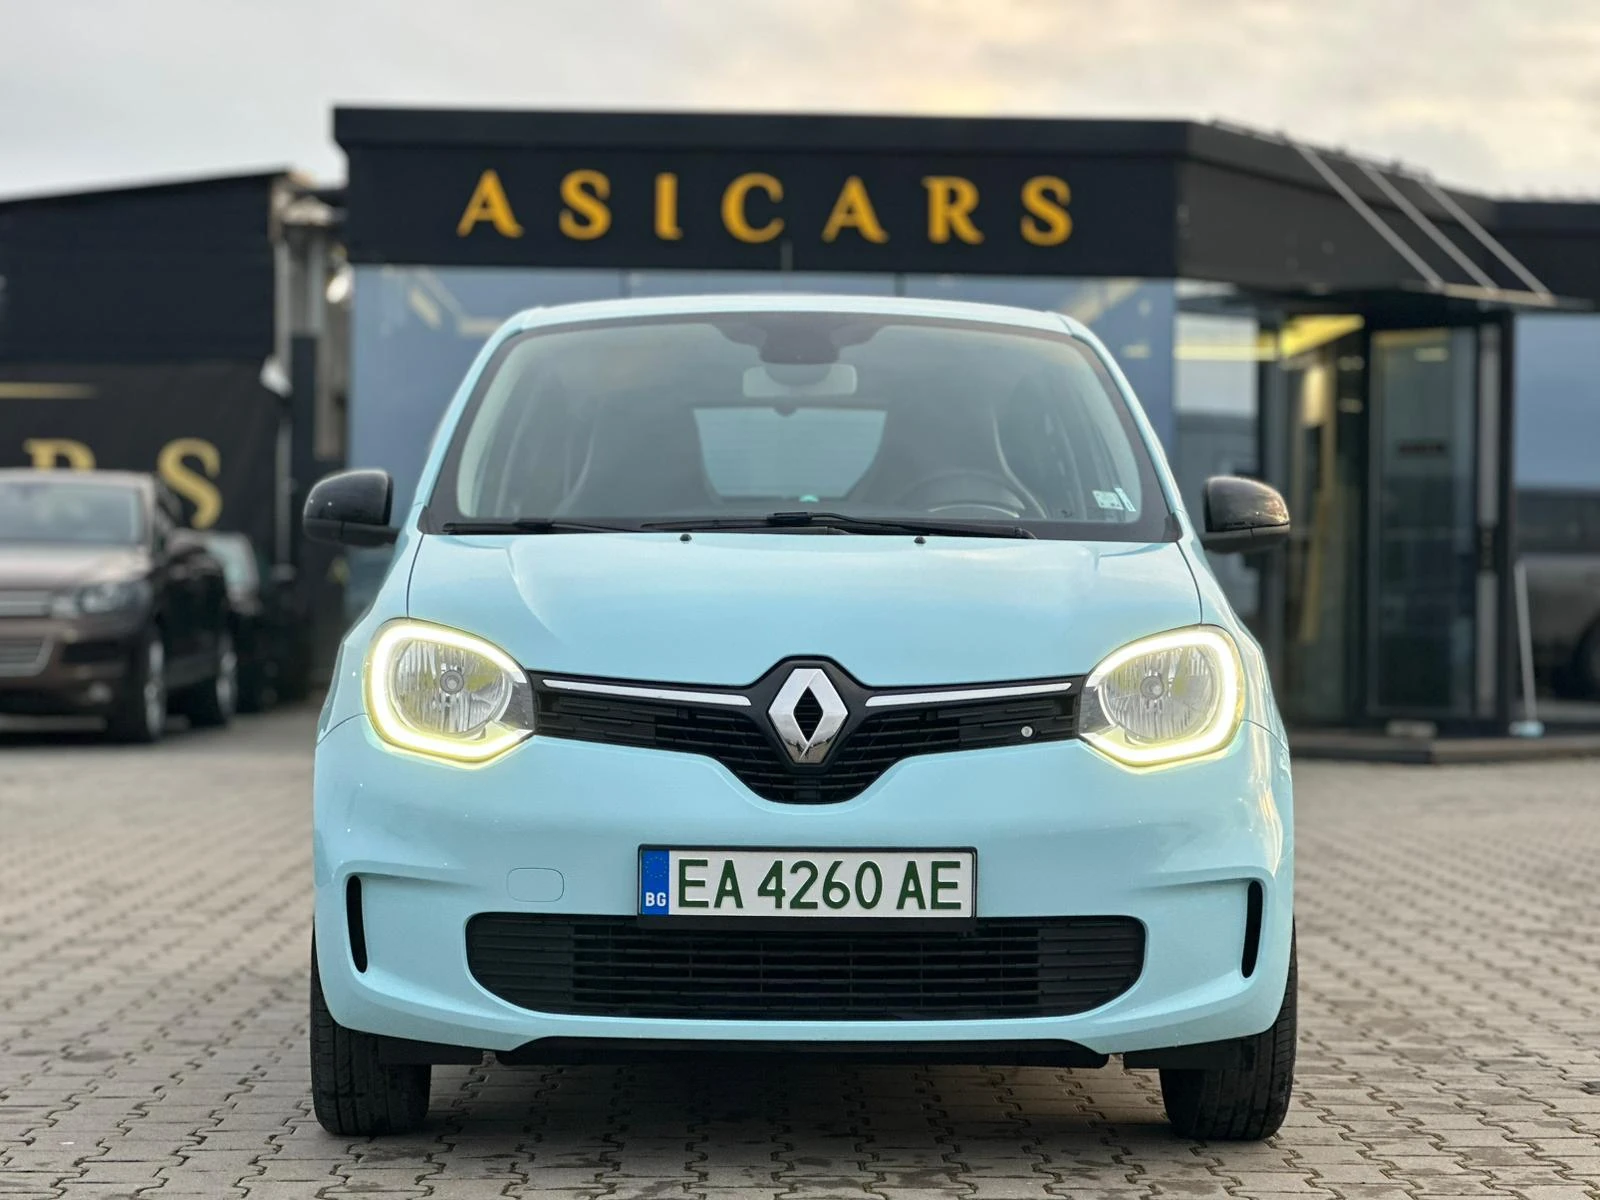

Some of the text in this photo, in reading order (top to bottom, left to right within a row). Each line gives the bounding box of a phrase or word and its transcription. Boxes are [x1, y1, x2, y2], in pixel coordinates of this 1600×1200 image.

[457, 169, 1073, 247] ASICARS
[645, 892, 667, 907] BG
[678, 858, 962, 910] EA 4260 AE
